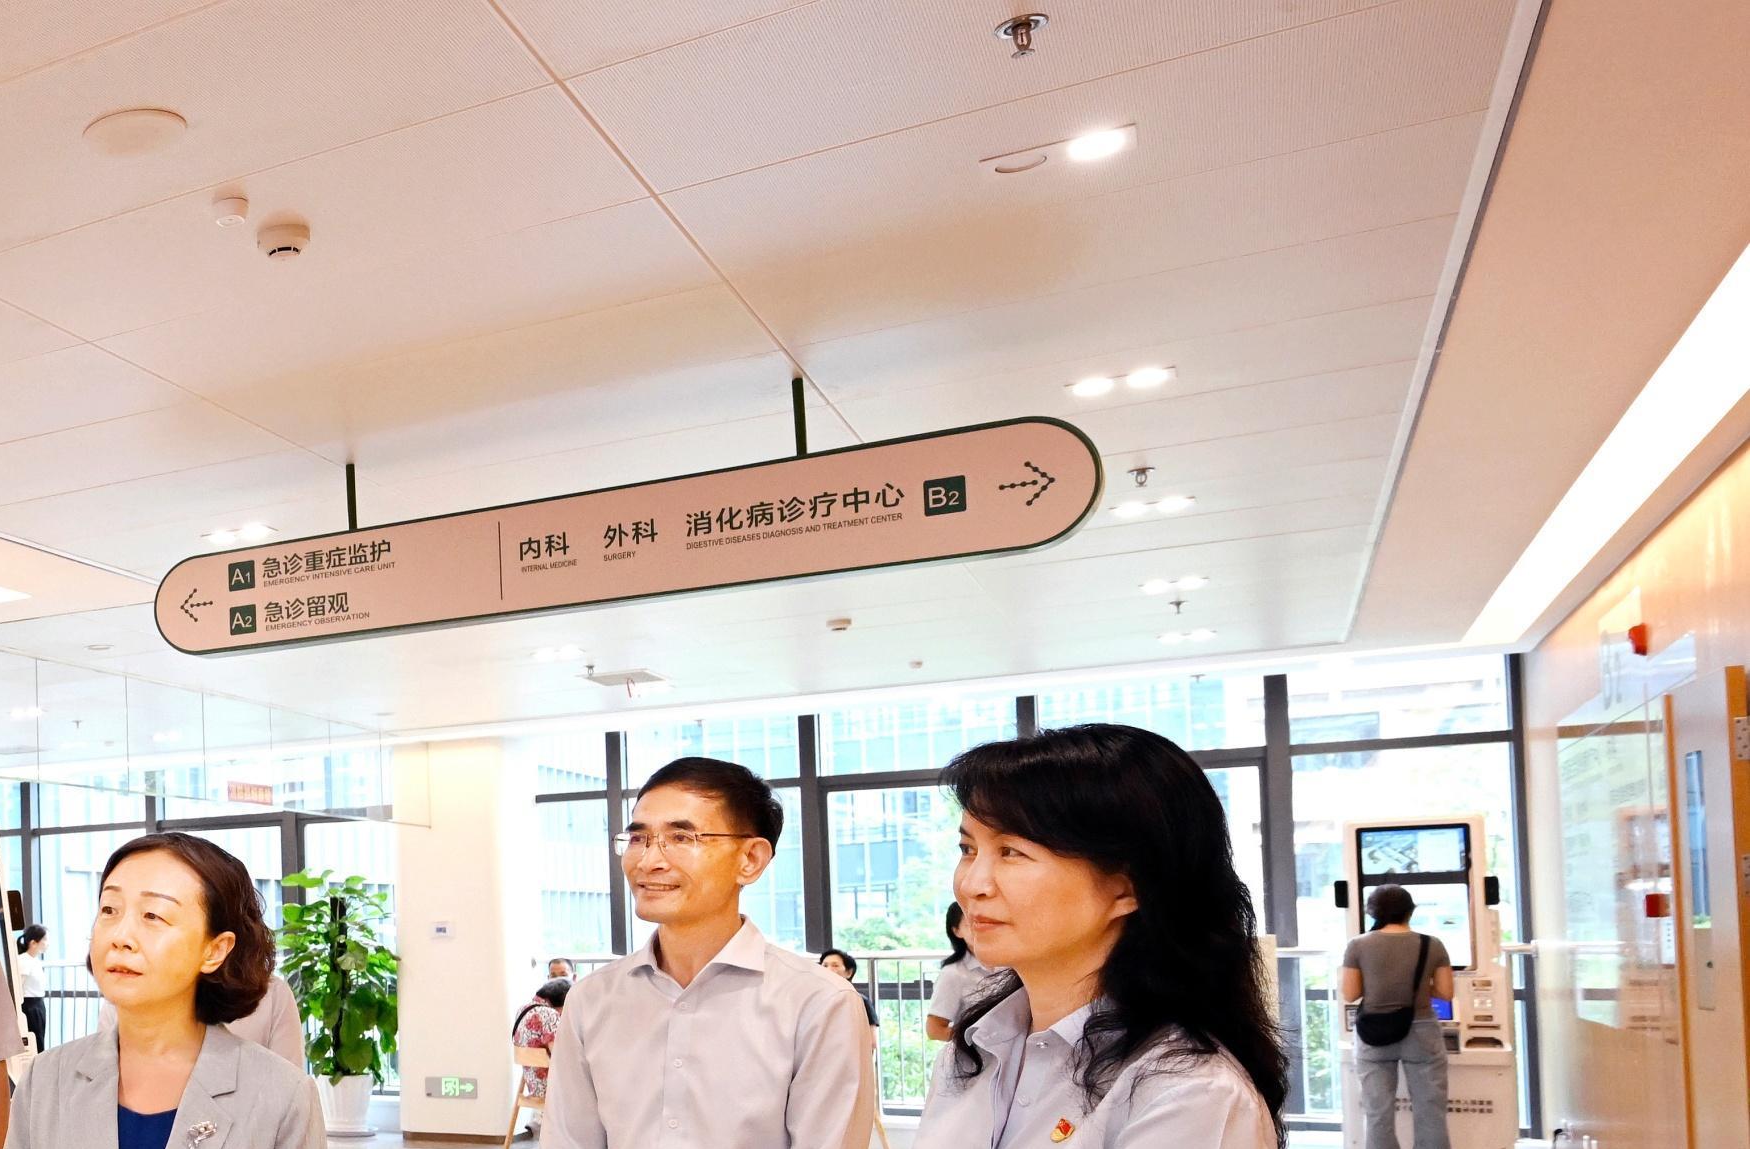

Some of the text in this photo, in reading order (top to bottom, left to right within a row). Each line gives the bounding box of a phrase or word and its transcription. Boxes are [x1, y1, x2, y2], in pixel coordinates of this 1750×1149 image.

[929, 486, 959, 508] B2
[686, 482, 905, 537] 消化病诊疗中心
[519, 518, 658, 561] 内科 外科
[686, 512, 903, 550] DIGESTIVE DISEASES DIAGNOSIS AND TREATMENT CENTER
[262, 540, 392, 580] 急诊重症监护
[521, 558, 578, 573] INTERNAL MEDICINE
[603, 550, 636, 562] SURGERY
[231, 569, 251, 586] A1
[263, 561, 396, 588] EMERGENCY INTENSIVE CARE UNIT
[264, 592, 349, 624] 急诊留观
[231, 612, 252, 629] A2
[265, 611, 370, 632] EMERGENCY OBSERVATION
